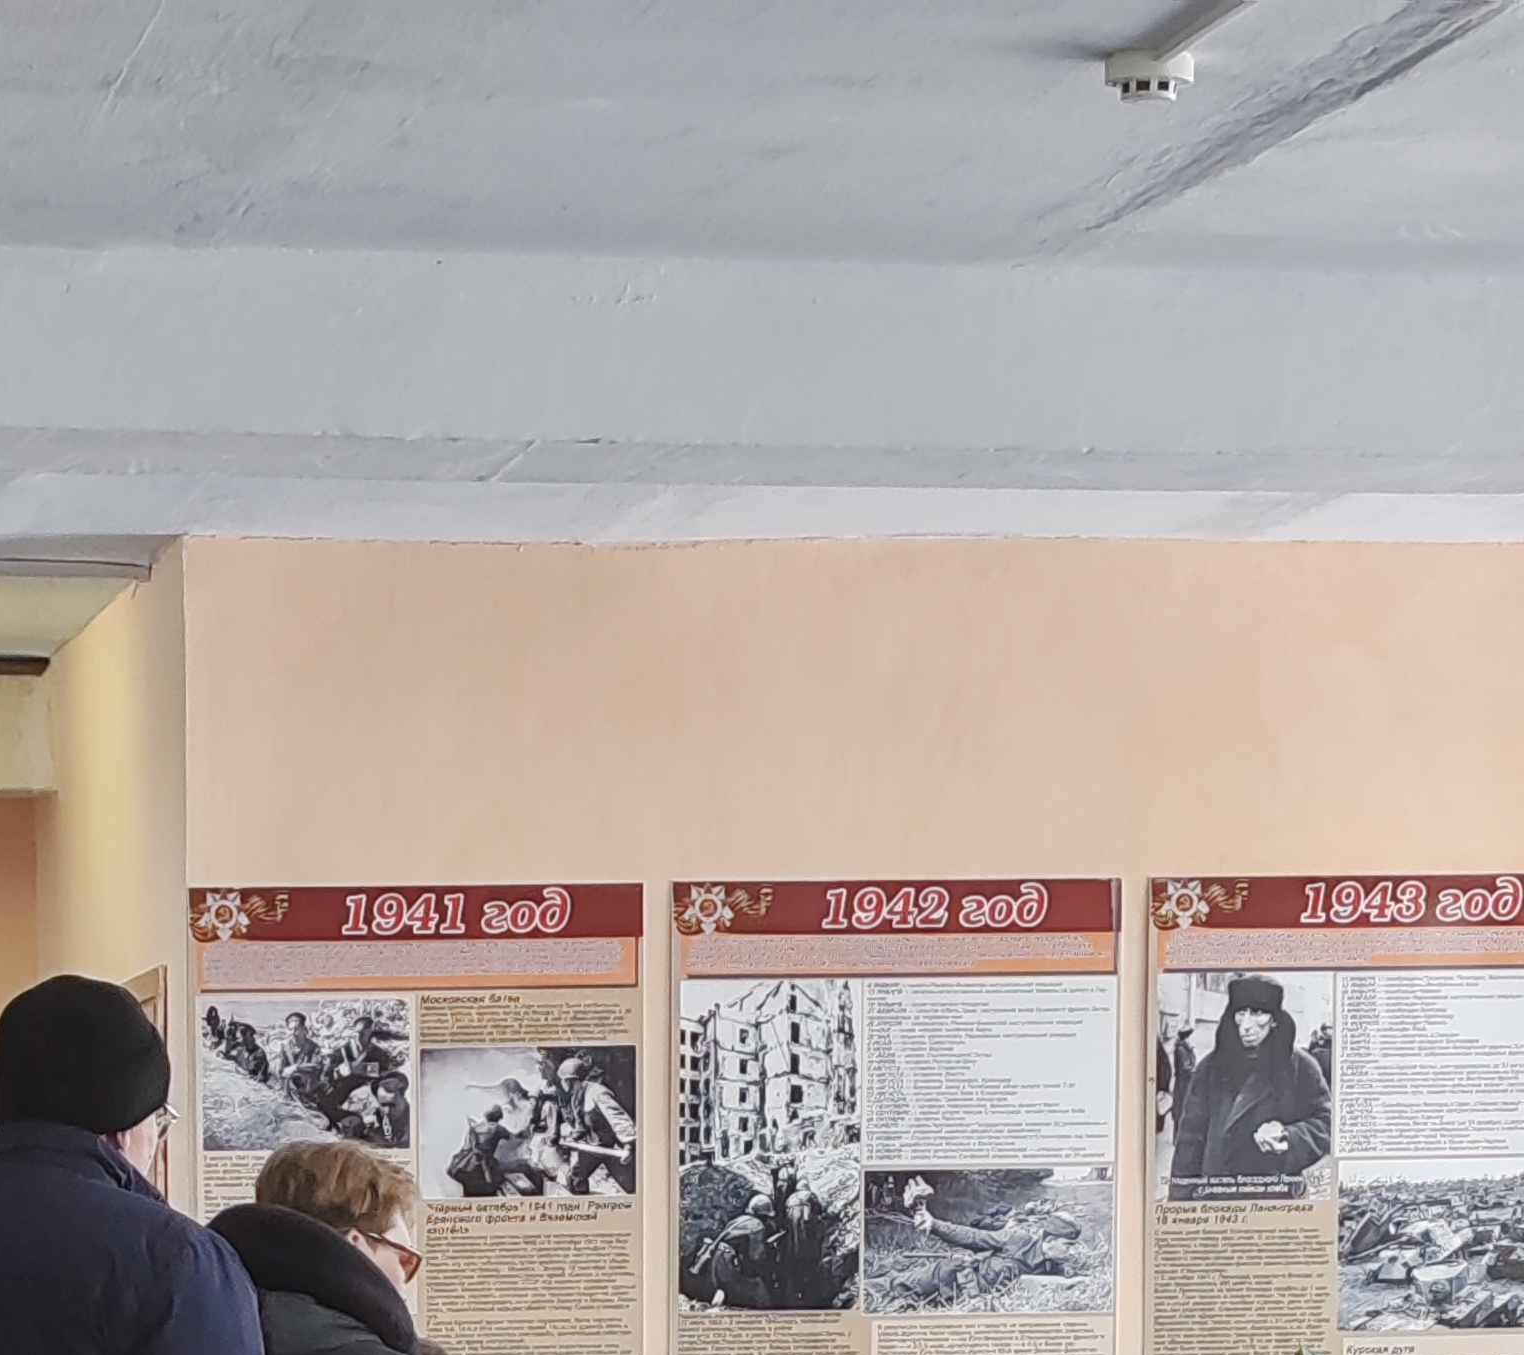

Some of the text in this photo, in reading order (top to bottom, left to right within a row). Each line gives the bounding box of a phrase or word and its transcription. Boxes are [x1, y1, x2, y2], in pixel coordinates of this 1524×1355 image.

[342, 887, 571, 935] 1941 год
[821, 882, 1048, 930] 1942 год
[1300, 876, 1523, 924] 1943 год
